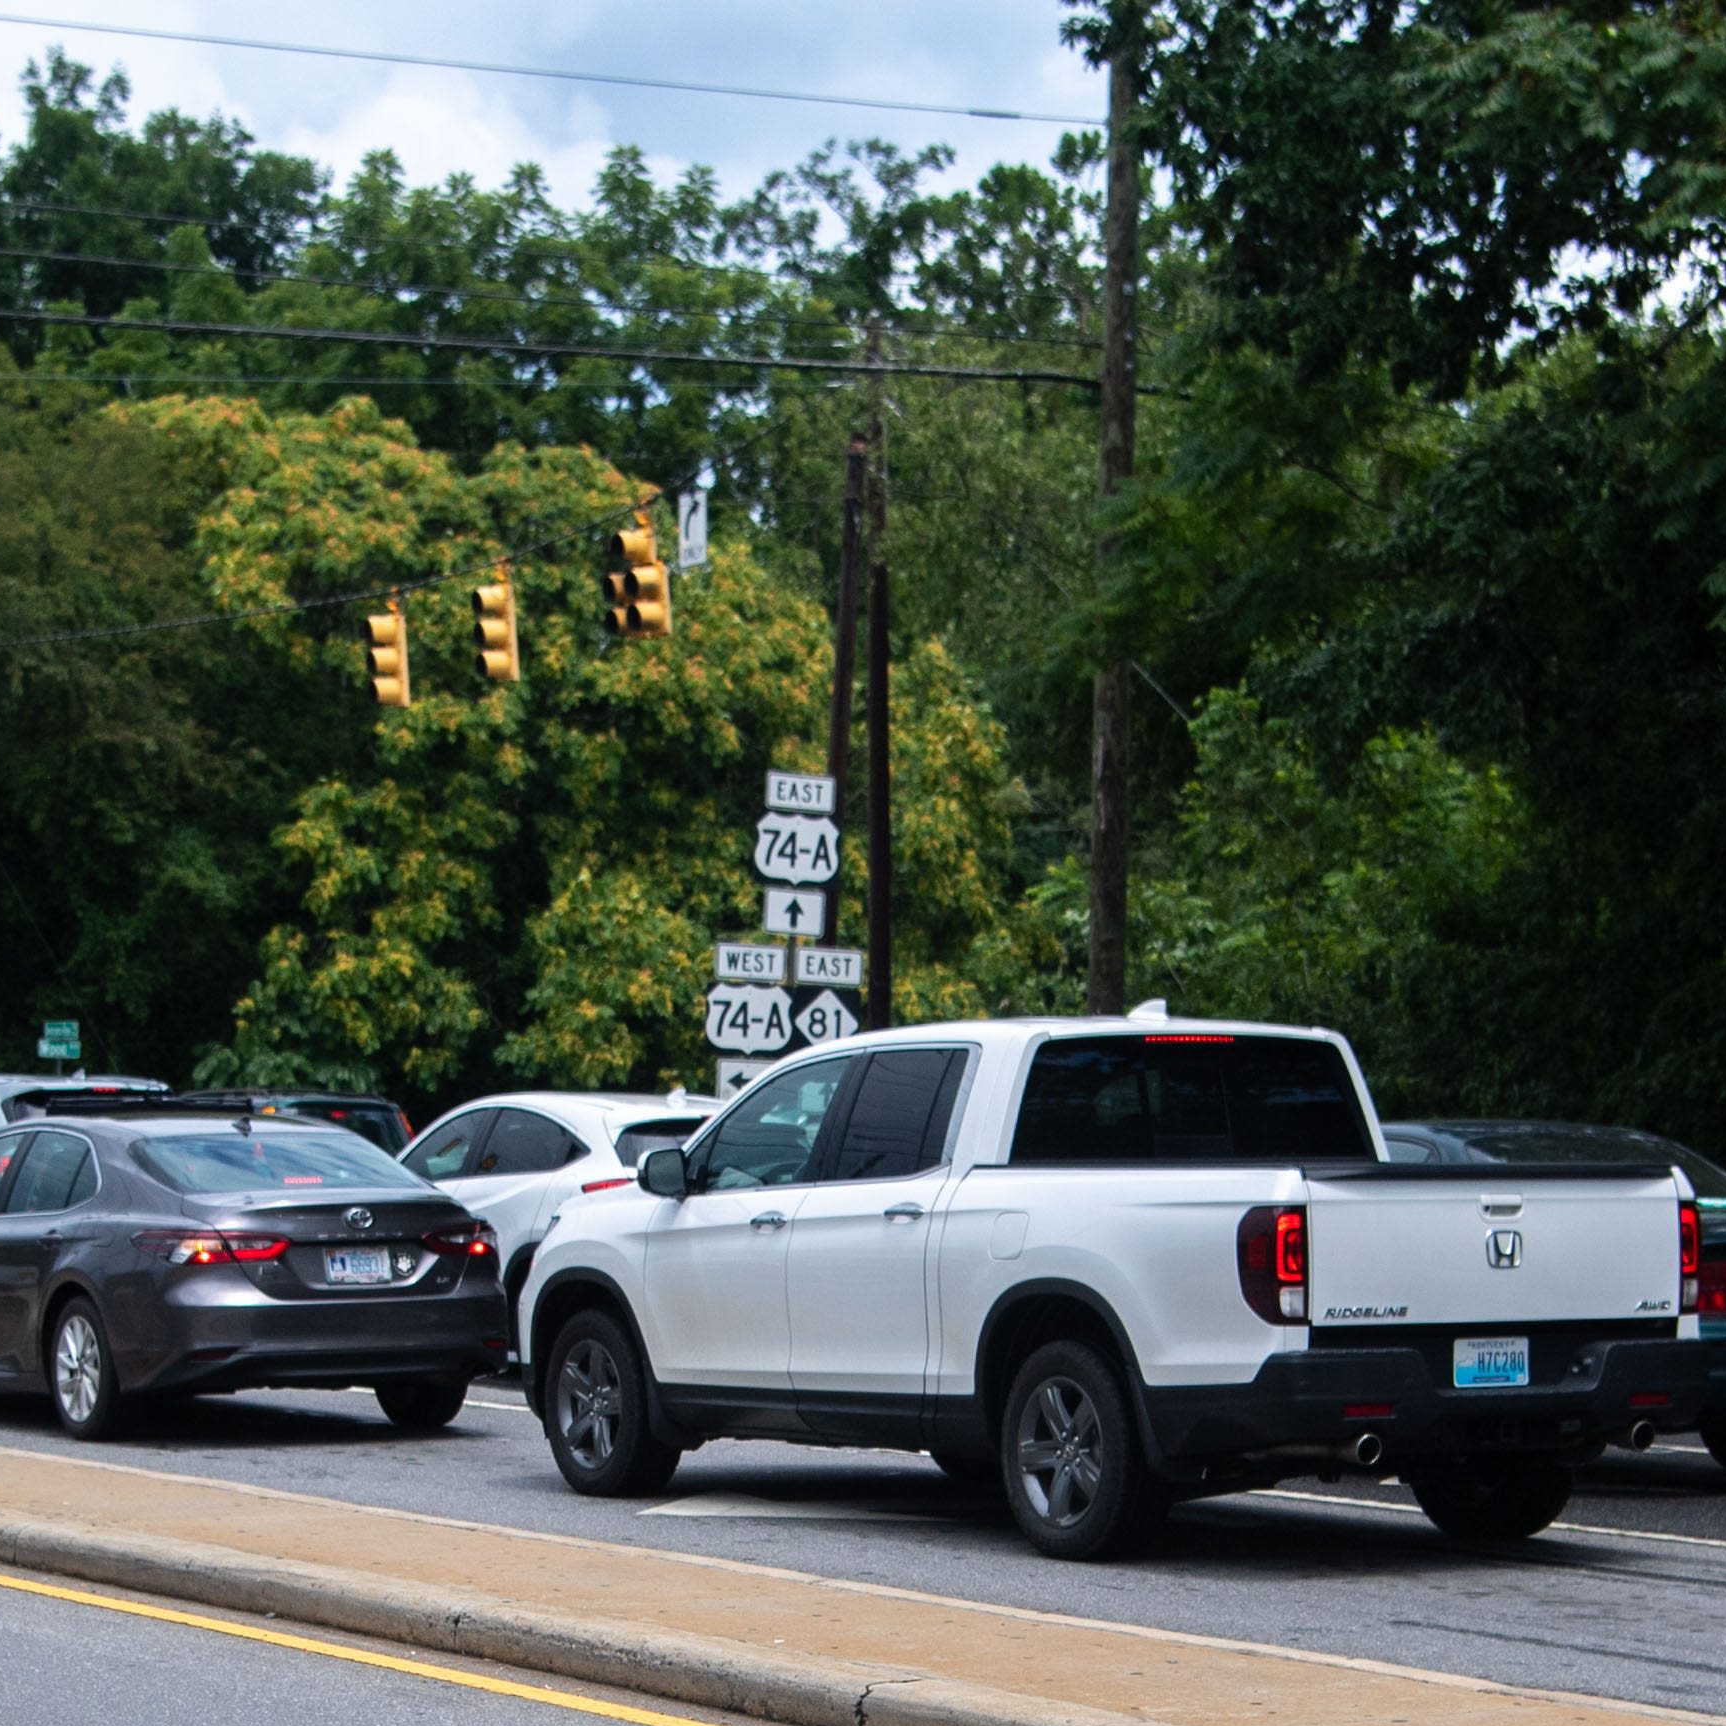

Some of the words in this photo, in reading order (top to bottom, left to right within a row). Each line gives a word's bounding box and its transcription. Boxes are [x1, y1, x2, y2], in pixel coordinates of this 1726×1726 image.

[777, 781, 824, 804] EAST
[762, 829, 832, 871] 74-A
[727, 952, 777, 974] WEST
[806, 956, 852, 977] EAST
[713, 1000, 785, 1039] 74-A
[808, 1008, 841, 1039] 81
[1325, 1307, 1408, 1319] RIDGELINE
[1636, 1299, 1670, 1311] AWD
[1477, 1350, 1525, 1373] H7C280
